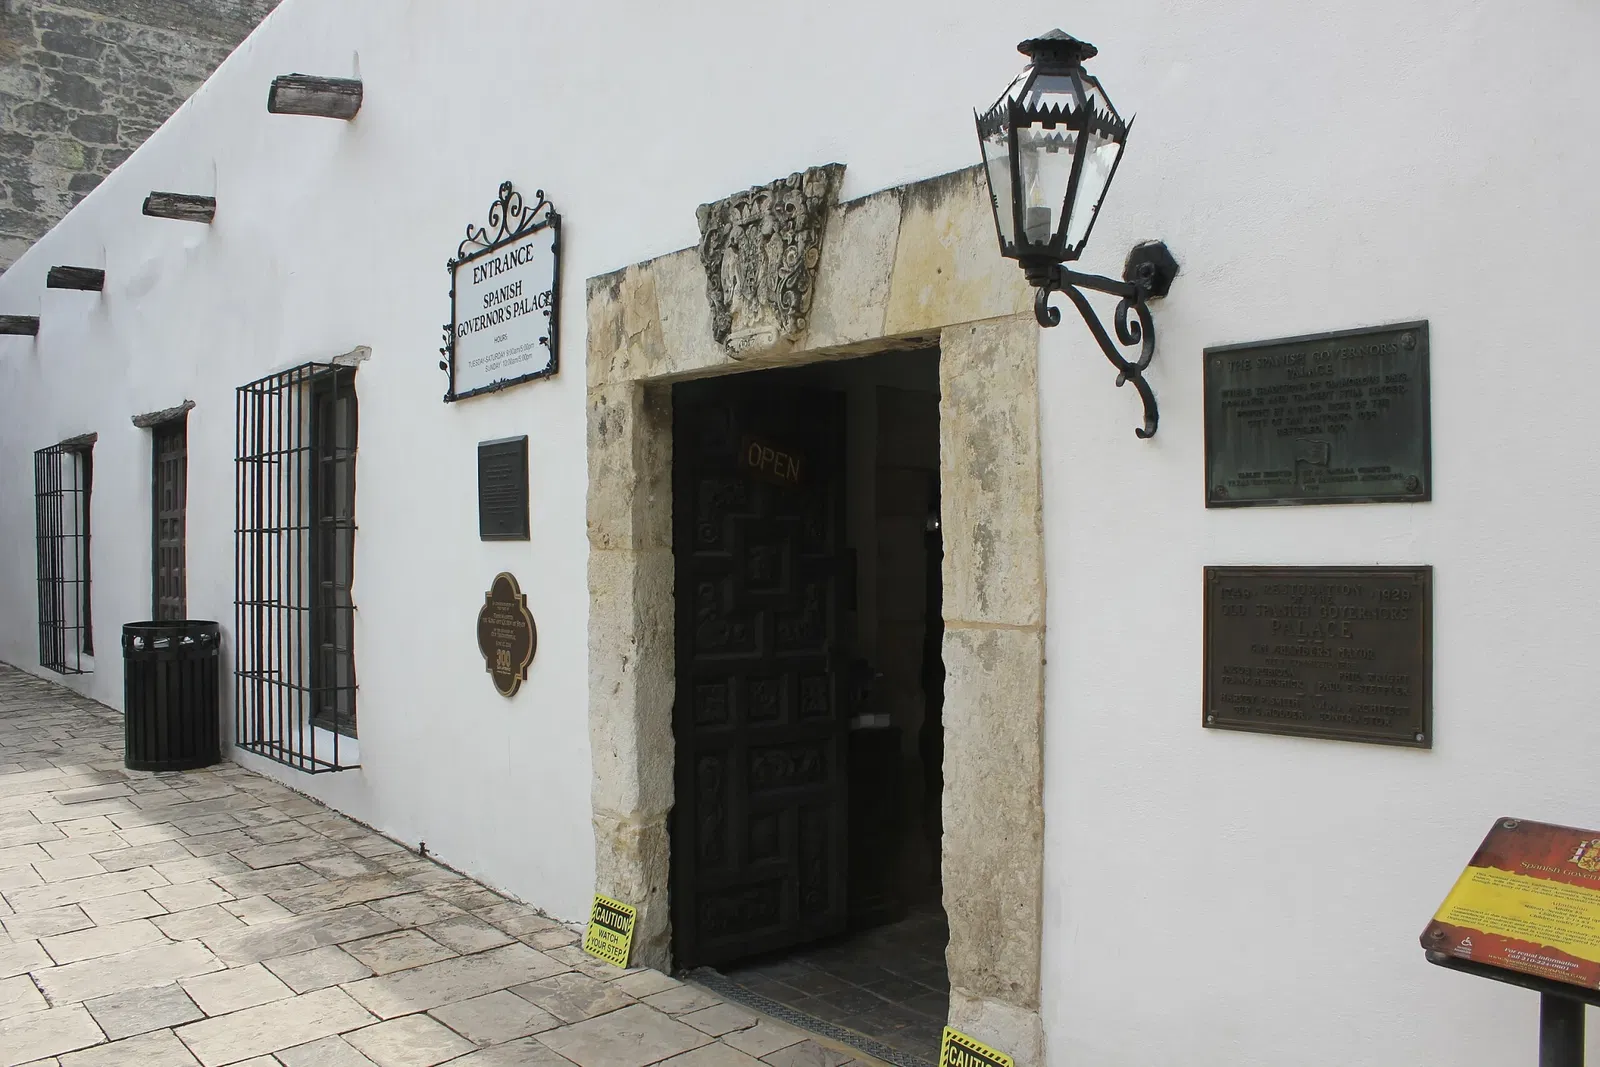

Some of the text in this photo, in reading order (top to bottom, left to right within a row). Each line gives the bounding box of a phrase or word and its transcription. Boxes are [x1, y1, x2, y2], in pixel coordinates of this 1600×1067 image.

[473, 243, 534, 285] ENTRANCE
[483, 280, 522, 309] SPANISH
[457, 289, 553, 338] GOVERNOR'S PALACE
[494, 333, 508, 344] HOURS
[1256, 352, 1306, 369] SPANISH
[748, 442, 800, 483] OPEN
[1271, 618, 1352, 639] PALACE
[1519, 861, 1561, 874] Spanish
[595, 906, 629, 932] CAUTION
[591, 936, 623, 957] YOUR STEP
[598, 928, 619, 944] WATCH
[1504, 947, 1580, 968] For rental information
[948, 1045, 993, 1067] CAUT
